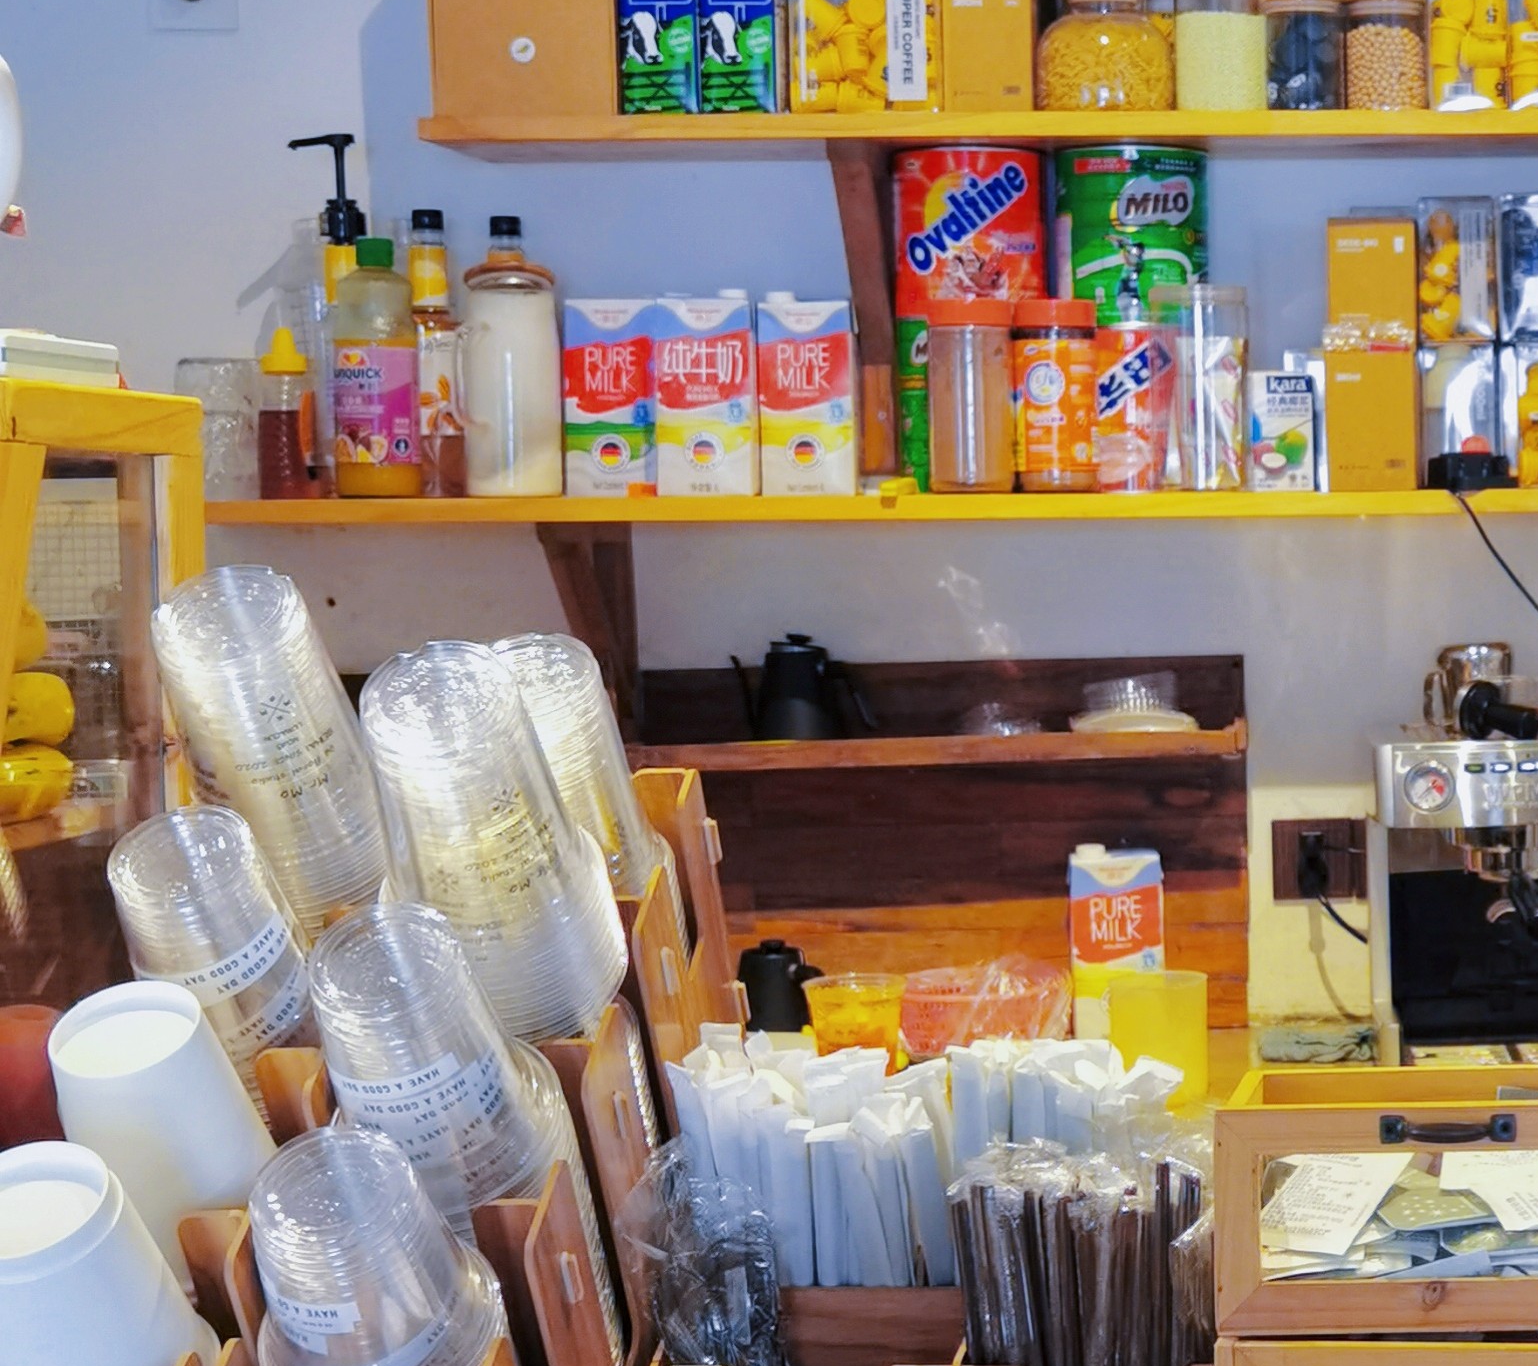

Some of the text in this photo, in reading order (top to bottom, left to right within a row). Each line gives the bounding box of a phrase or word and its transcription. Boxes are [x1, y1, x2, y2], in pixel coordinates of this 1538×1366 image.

[902, 33, 914, 85] COFFEE
[1124, 191, 1189, 218] MILO
[906, 160, 1030, 276] Ovaltine
[583, 346, 637, 370] PURE
[662, 340, 744, 385] 纯牛奶
[776, 343, 831, 367] PURE
[585, 369, 637, 392] MILK
[777, 366, 831, 390] MILK
[1268, 376, 1308, 392] kara
[1088, 896, 1143, 919] PURE
[1090, 919, 1143, 943] MILK
[408, 1068, 441, 1087] HAVE
